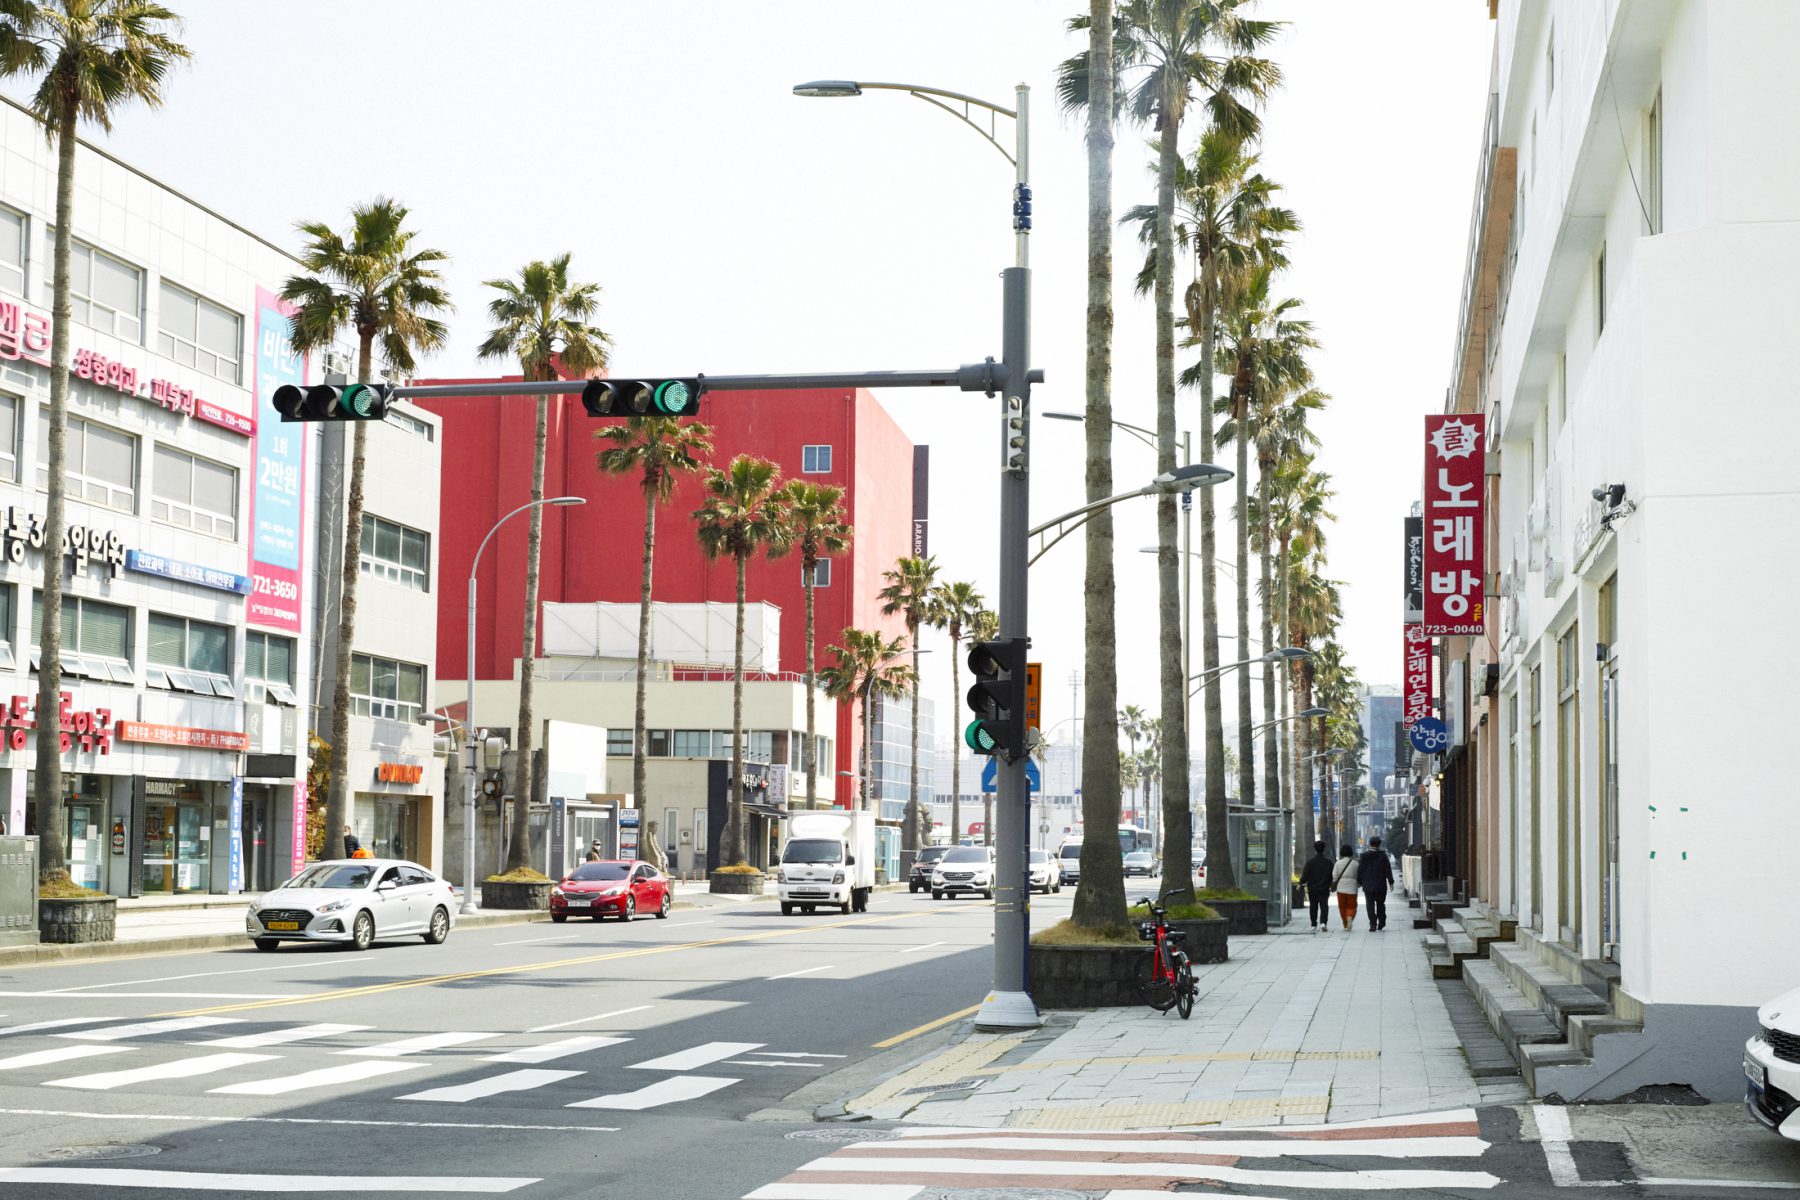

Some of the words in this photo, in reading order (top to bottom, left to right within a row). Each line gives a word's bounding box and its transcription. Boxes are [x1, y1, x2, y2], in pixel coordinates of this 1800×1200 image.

[73, 348, 137, 396] 성형외과
[151, 379, 194, 417] 피부과
[260, 456, 298, 496] 2만원
[914, 523, 922, 554] ARARIO
[1431, 468, 1481, 617] 노래방
[253, 574, 297, 600] 721-3650
[1426, 625, 1483, 634] 723-0040
[1473, 603, 1482, 622] 2F
[1407, 645, 1431, 720] 노래연습장
